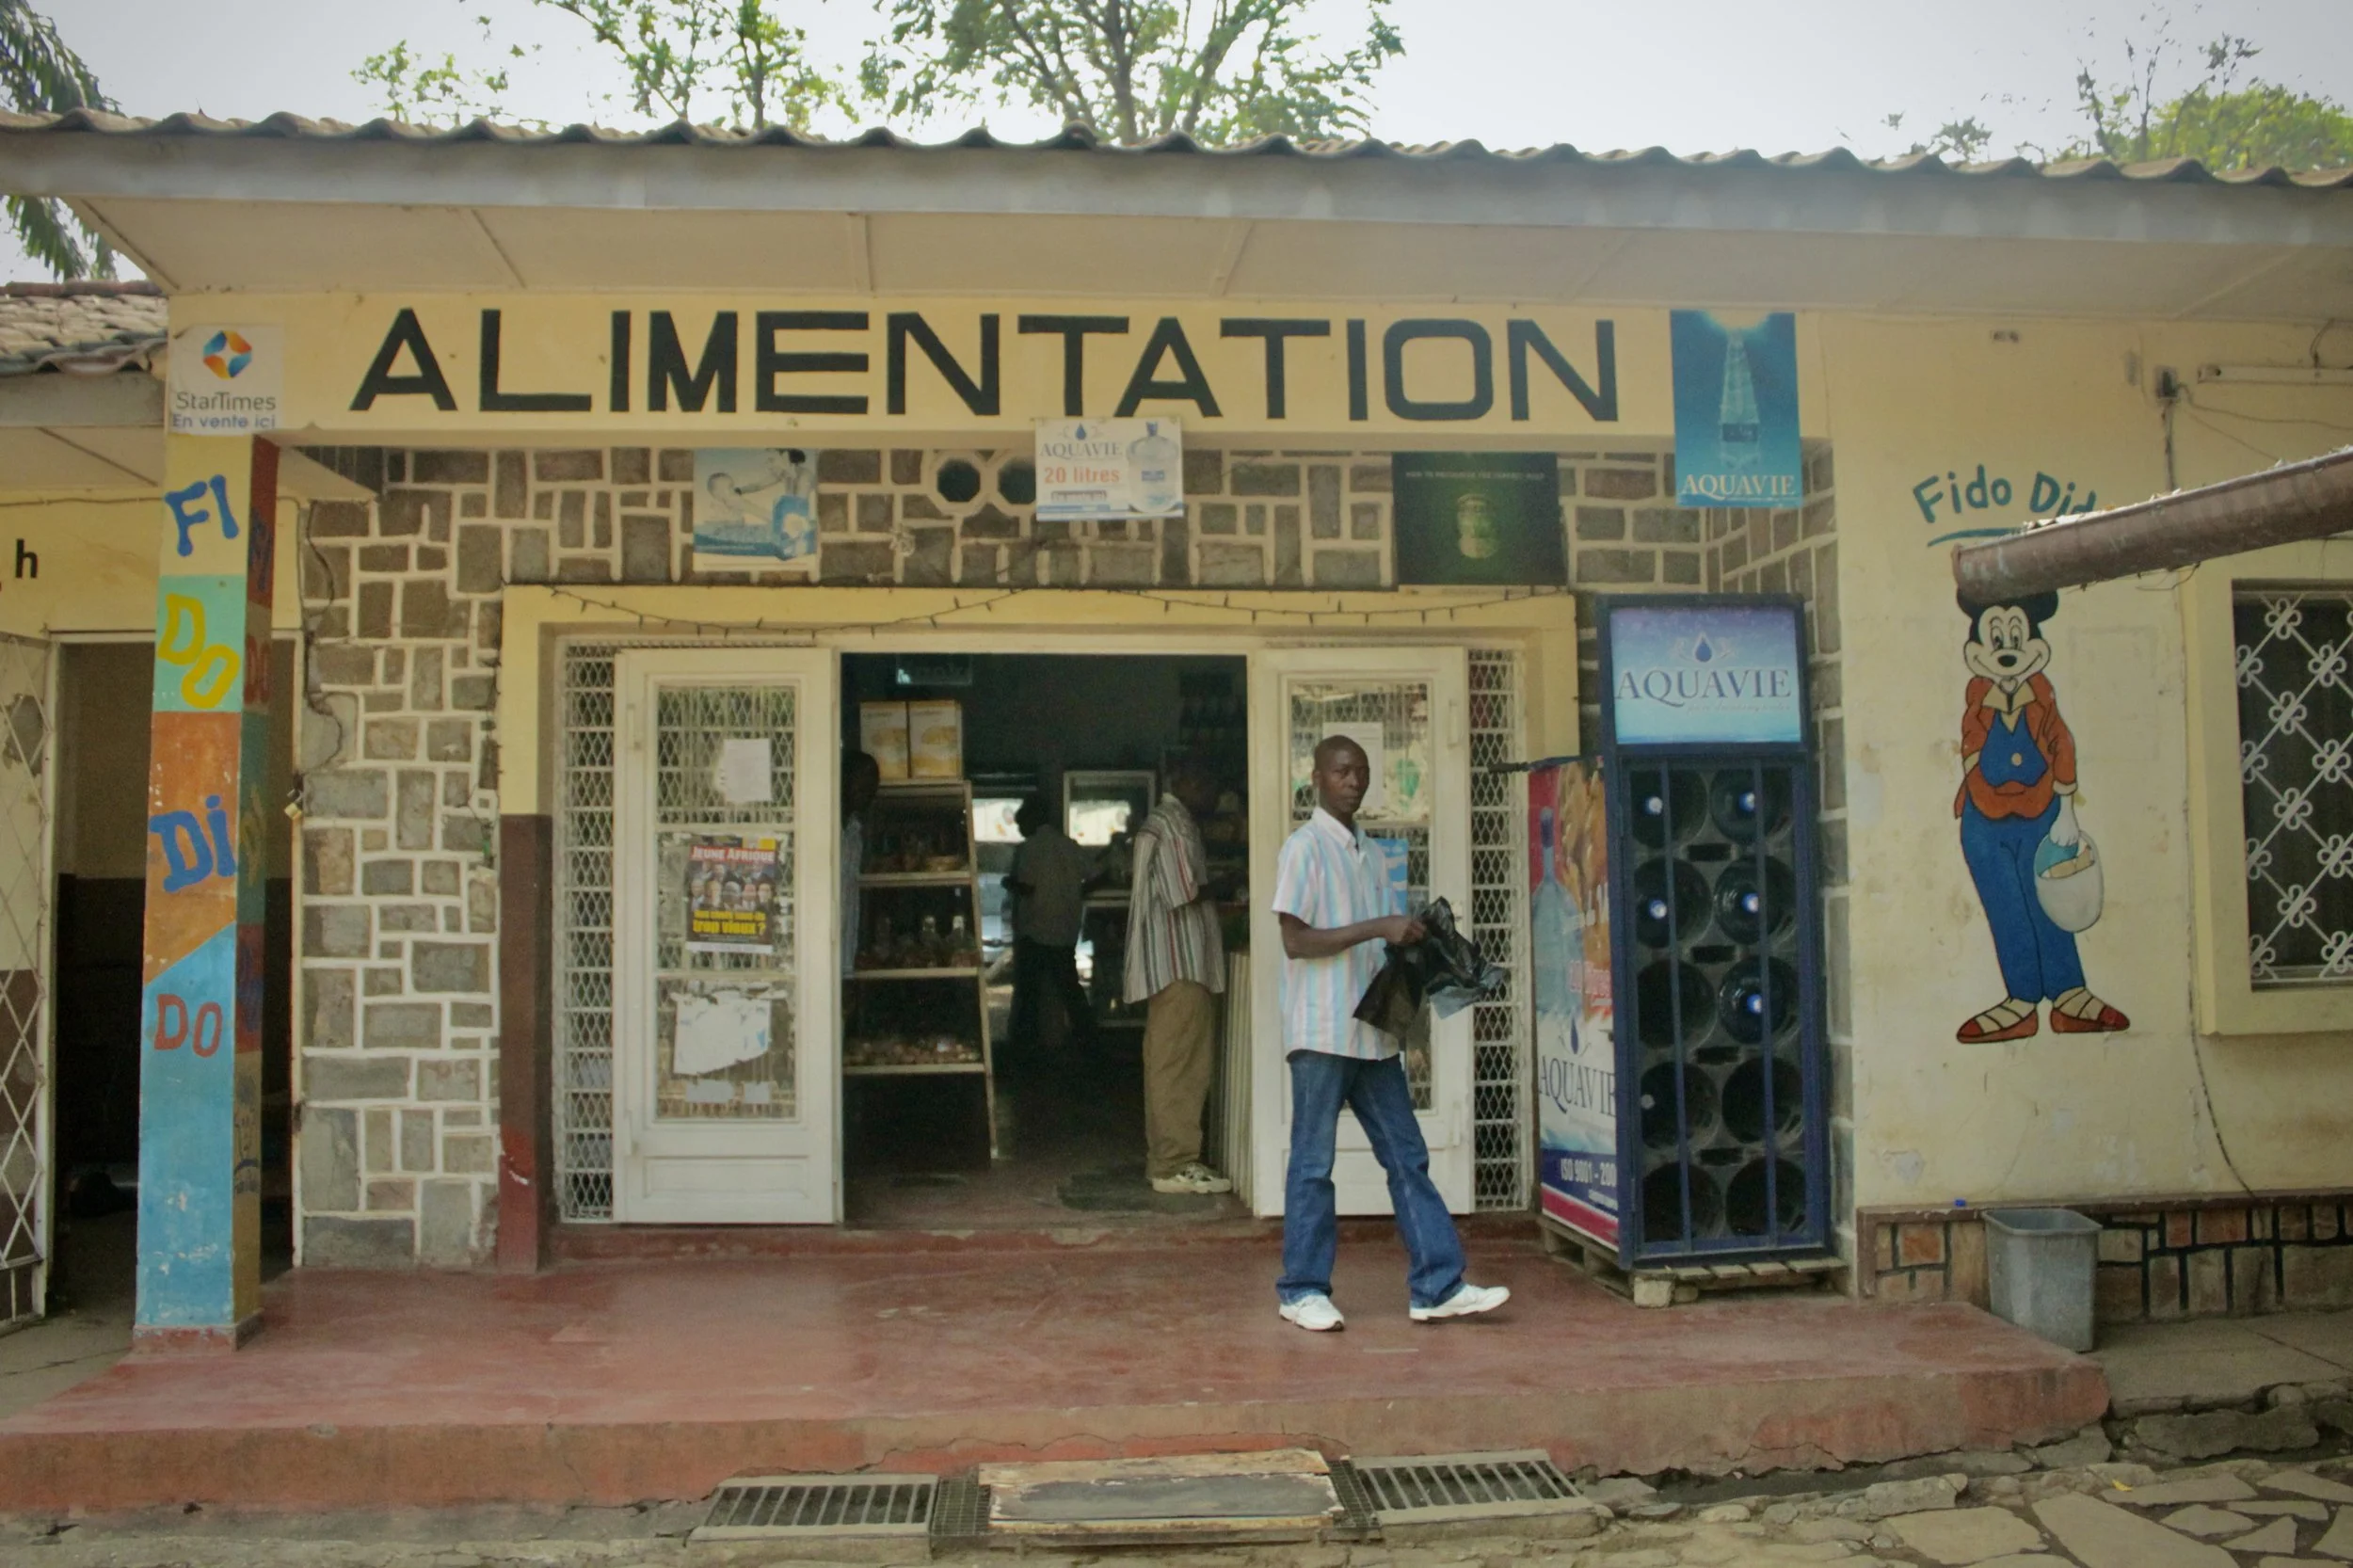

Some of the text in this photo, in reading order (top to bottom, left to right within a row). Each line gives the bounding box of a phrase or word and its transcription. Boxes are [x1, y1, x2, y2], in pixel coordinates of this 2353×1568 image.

[349, 307, 1618, 423] ALIMENTATION
[176, 391, 277, 410] StarTimes
[172, 414, 193, 427] En
[200, 415, 248, 428] vente
[1039, 442, 1123, 459] AQUAVIE
[1044, 466, 1120, 484] 20 litres
[1680, 473, 1796, 501] AQUAVIE
[1913, 464, 2012, 523] Fido
[164, 474, 240, 557] FI
[156, 592, 241, 710] DO
[1614, 668, 1792, 708] AQUAVIE
[148, 794, 237, 893] Di
[692, 846, 775, 863] JEUNE AFRIQUE
[153, 993, 223, 1058] DO
